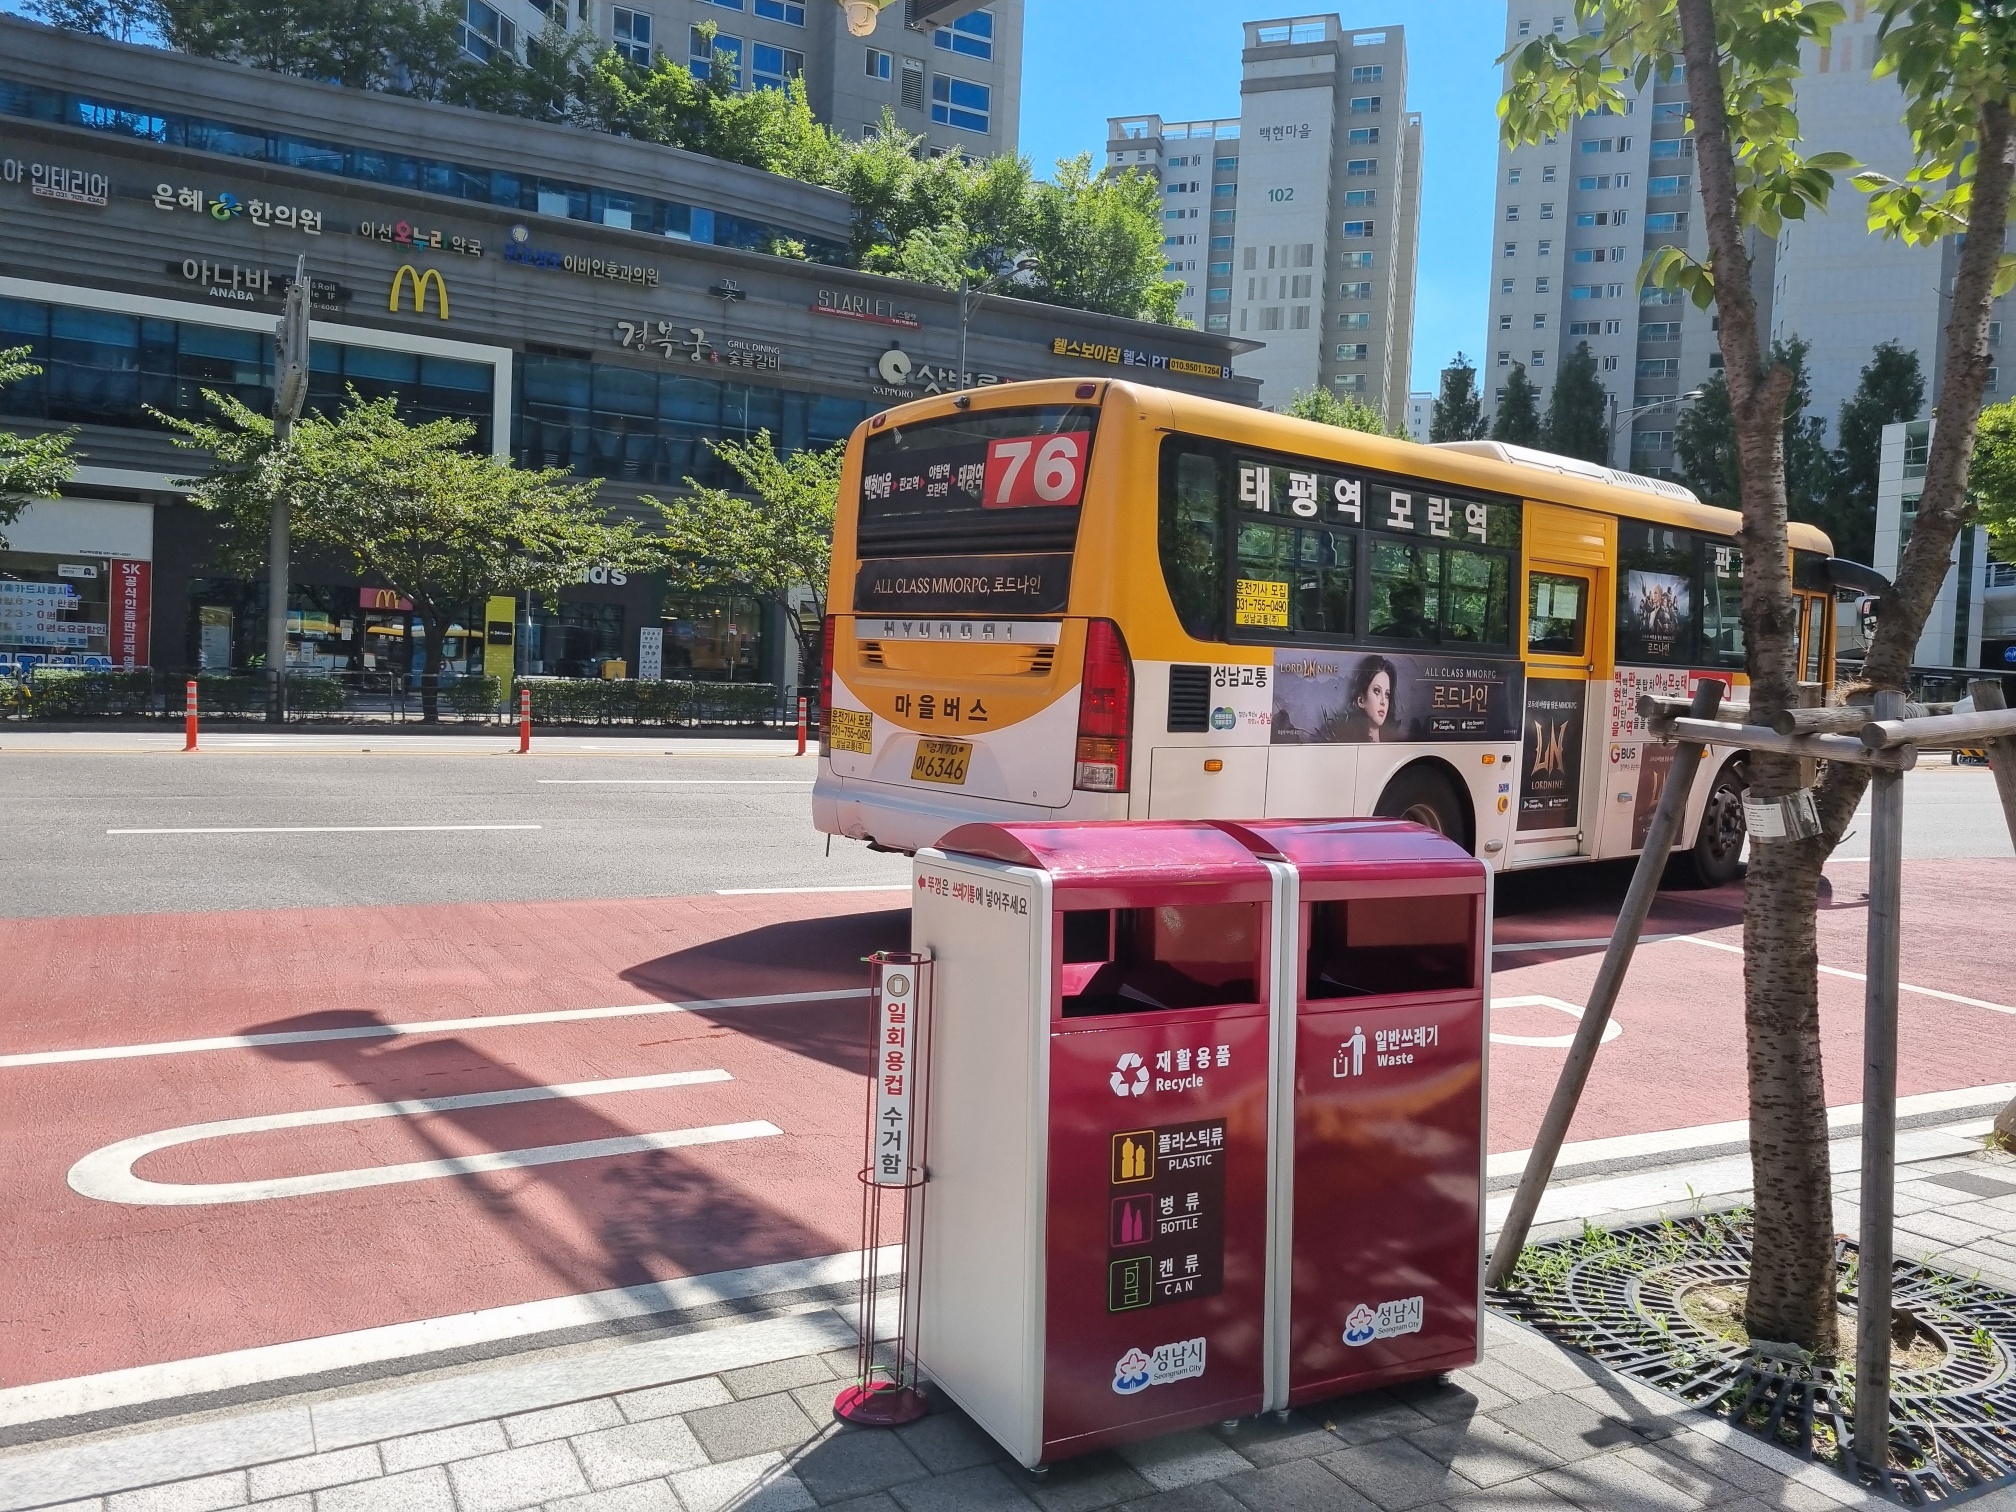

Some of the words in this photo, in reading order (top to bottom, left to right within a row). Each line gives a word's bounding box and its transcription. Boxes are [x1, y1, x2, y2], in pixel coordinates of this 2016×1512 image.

[1259, 123, 1312, 141] 백현마을
[31, 163, 109, 198] 인테리어
[1268, 187, 1294, 202] 102
[152, 183, 203, 213] 은혜
[248, 198, 322, 236] 한의원
[182, 258, 273, 295] 아나바
[563, 254, 660, 288] 이비인후과의원
[209, 286, 255, 302] ANABA
[719, 278, 740, 303] 꽃
[818, 289, 894, 318] STARLET
[617, 320, 713, 362] 경복궁
[727, 340, 750, 351] GRILL
[752, 343, 780, 355] DINING
[1053, 337, 1122, 364] 헬스보이짐
[1171, 360, 1220, 376] 010.9501.1264
[1222, 367, 1235, 379] B1
[872, 386, 914, 399] SAPPORO
[928, 463, 951, 479] 야탑역
[993, 436, 1079, 504] 76
[864, 472, 892, 500] 백현마을
[899, 475, 920, 491] 판교역
[926, 482, 949, 497] 모란역
[957, 462, 985, 491] 태평역
[1240, 467, 1361, 523] 태평역
[1387, 491, 1487, 544] 모란역
[121, 563, 141, 575] SK
[873, 577, 894, 594] ALL
[895, 577, 930, 594] CLASS
[931, 576, 991, 596] MMORPG,
[993, 575, 1042, 595] 로드나인
[1236, 581, 1268, 597] 운전기사
[1269, 583, 1287, 598] 모집
[1236, 598, 1287, 613] 031-755-0490
[1242, 612, 1280, 626] 성남교통(주)
[884, 620, 1013, 641] HYUNDAI
[1213, 666, 1268, 688] 성남교통
[1280, 662, 1303, 673] LORD
[1317, 664, 1338, 675] NINE
[1425, 668, 1439, 677] ALL
[1441, 668, 1464, 678] CLASS
[1466, 669, 1497, 679] MMORPG
[895, 693, 988, 723] 마을버스
[1431, 684, 1488, 713] 로드나인
[832, 709, 856, 726] 운전기사
[857, 715, 871, 727] 모집
[1531, 780, 1564, 790] LORDNINE
[927, 875, 949, 897] 뚜껑은
[952, 881, 984, 906] 쓰레기통에
[985, 889, 1028, 916] 넣어주세요
[1375, 1024, 1439, 1052] 일반쓰레기
[884, 1002, 907, 1097] 일회용컵
[1156, 1044, 1231, 1073] 재활용품
[1377, 1052, 1414, 1067] Waste
[1156, 1074, 1204, 1093] Recycle
[881, 1106, 903, 1176] 수거함
[1158, 1127, 1224, 1154] 플라스틱류
[1168, 1154, 1213, 1171] PLASTIC
[1160, 1218, 1199, 1234] BOTTLE
[1164, 1280, 1194, 1296] CAN
[1378, 1299, 1422, 1328] 성남시
[1377, 1324, 1408, 1336] Seongnam
[1408, 1320, 1420, 1332] City
[1153, 1341, 1203, 1372] 성남시
[1153, 1368, 1188, 1381] Seongnam
[1188, 1364, 1202, 1375] City
